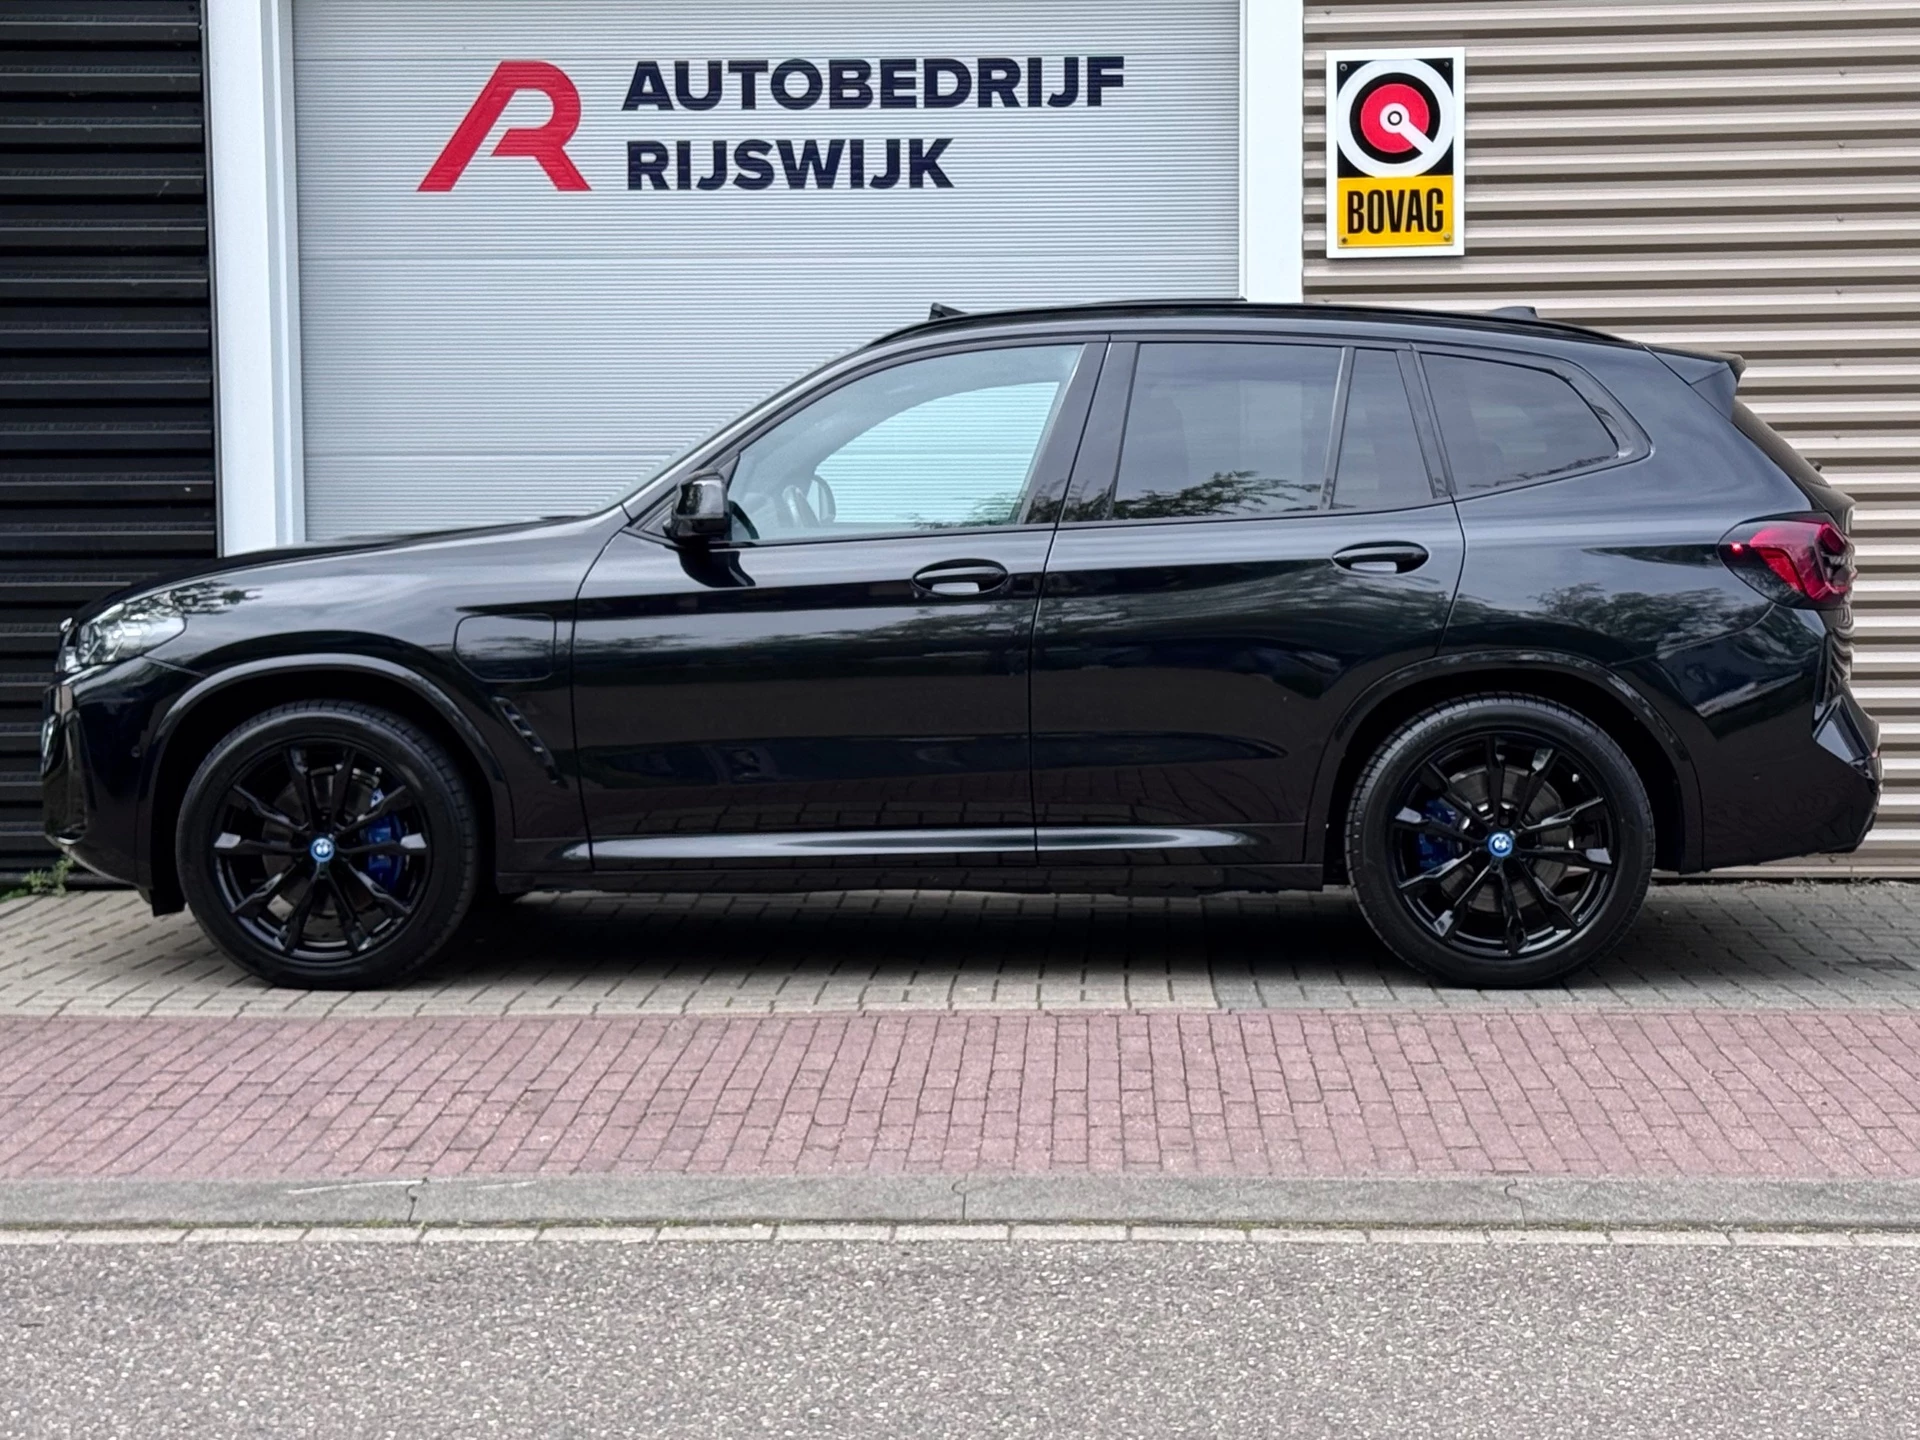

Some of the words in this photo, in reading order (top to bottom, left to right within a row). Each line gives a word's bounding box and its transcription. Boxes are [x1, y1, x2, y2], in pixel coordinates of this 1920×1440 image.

[622, 56, 1124, 111] AUTOBEDRIJF
[627, 138, 953, 190] RIJSWIJK
[1347, 188, 1444, 234] BOVAG
